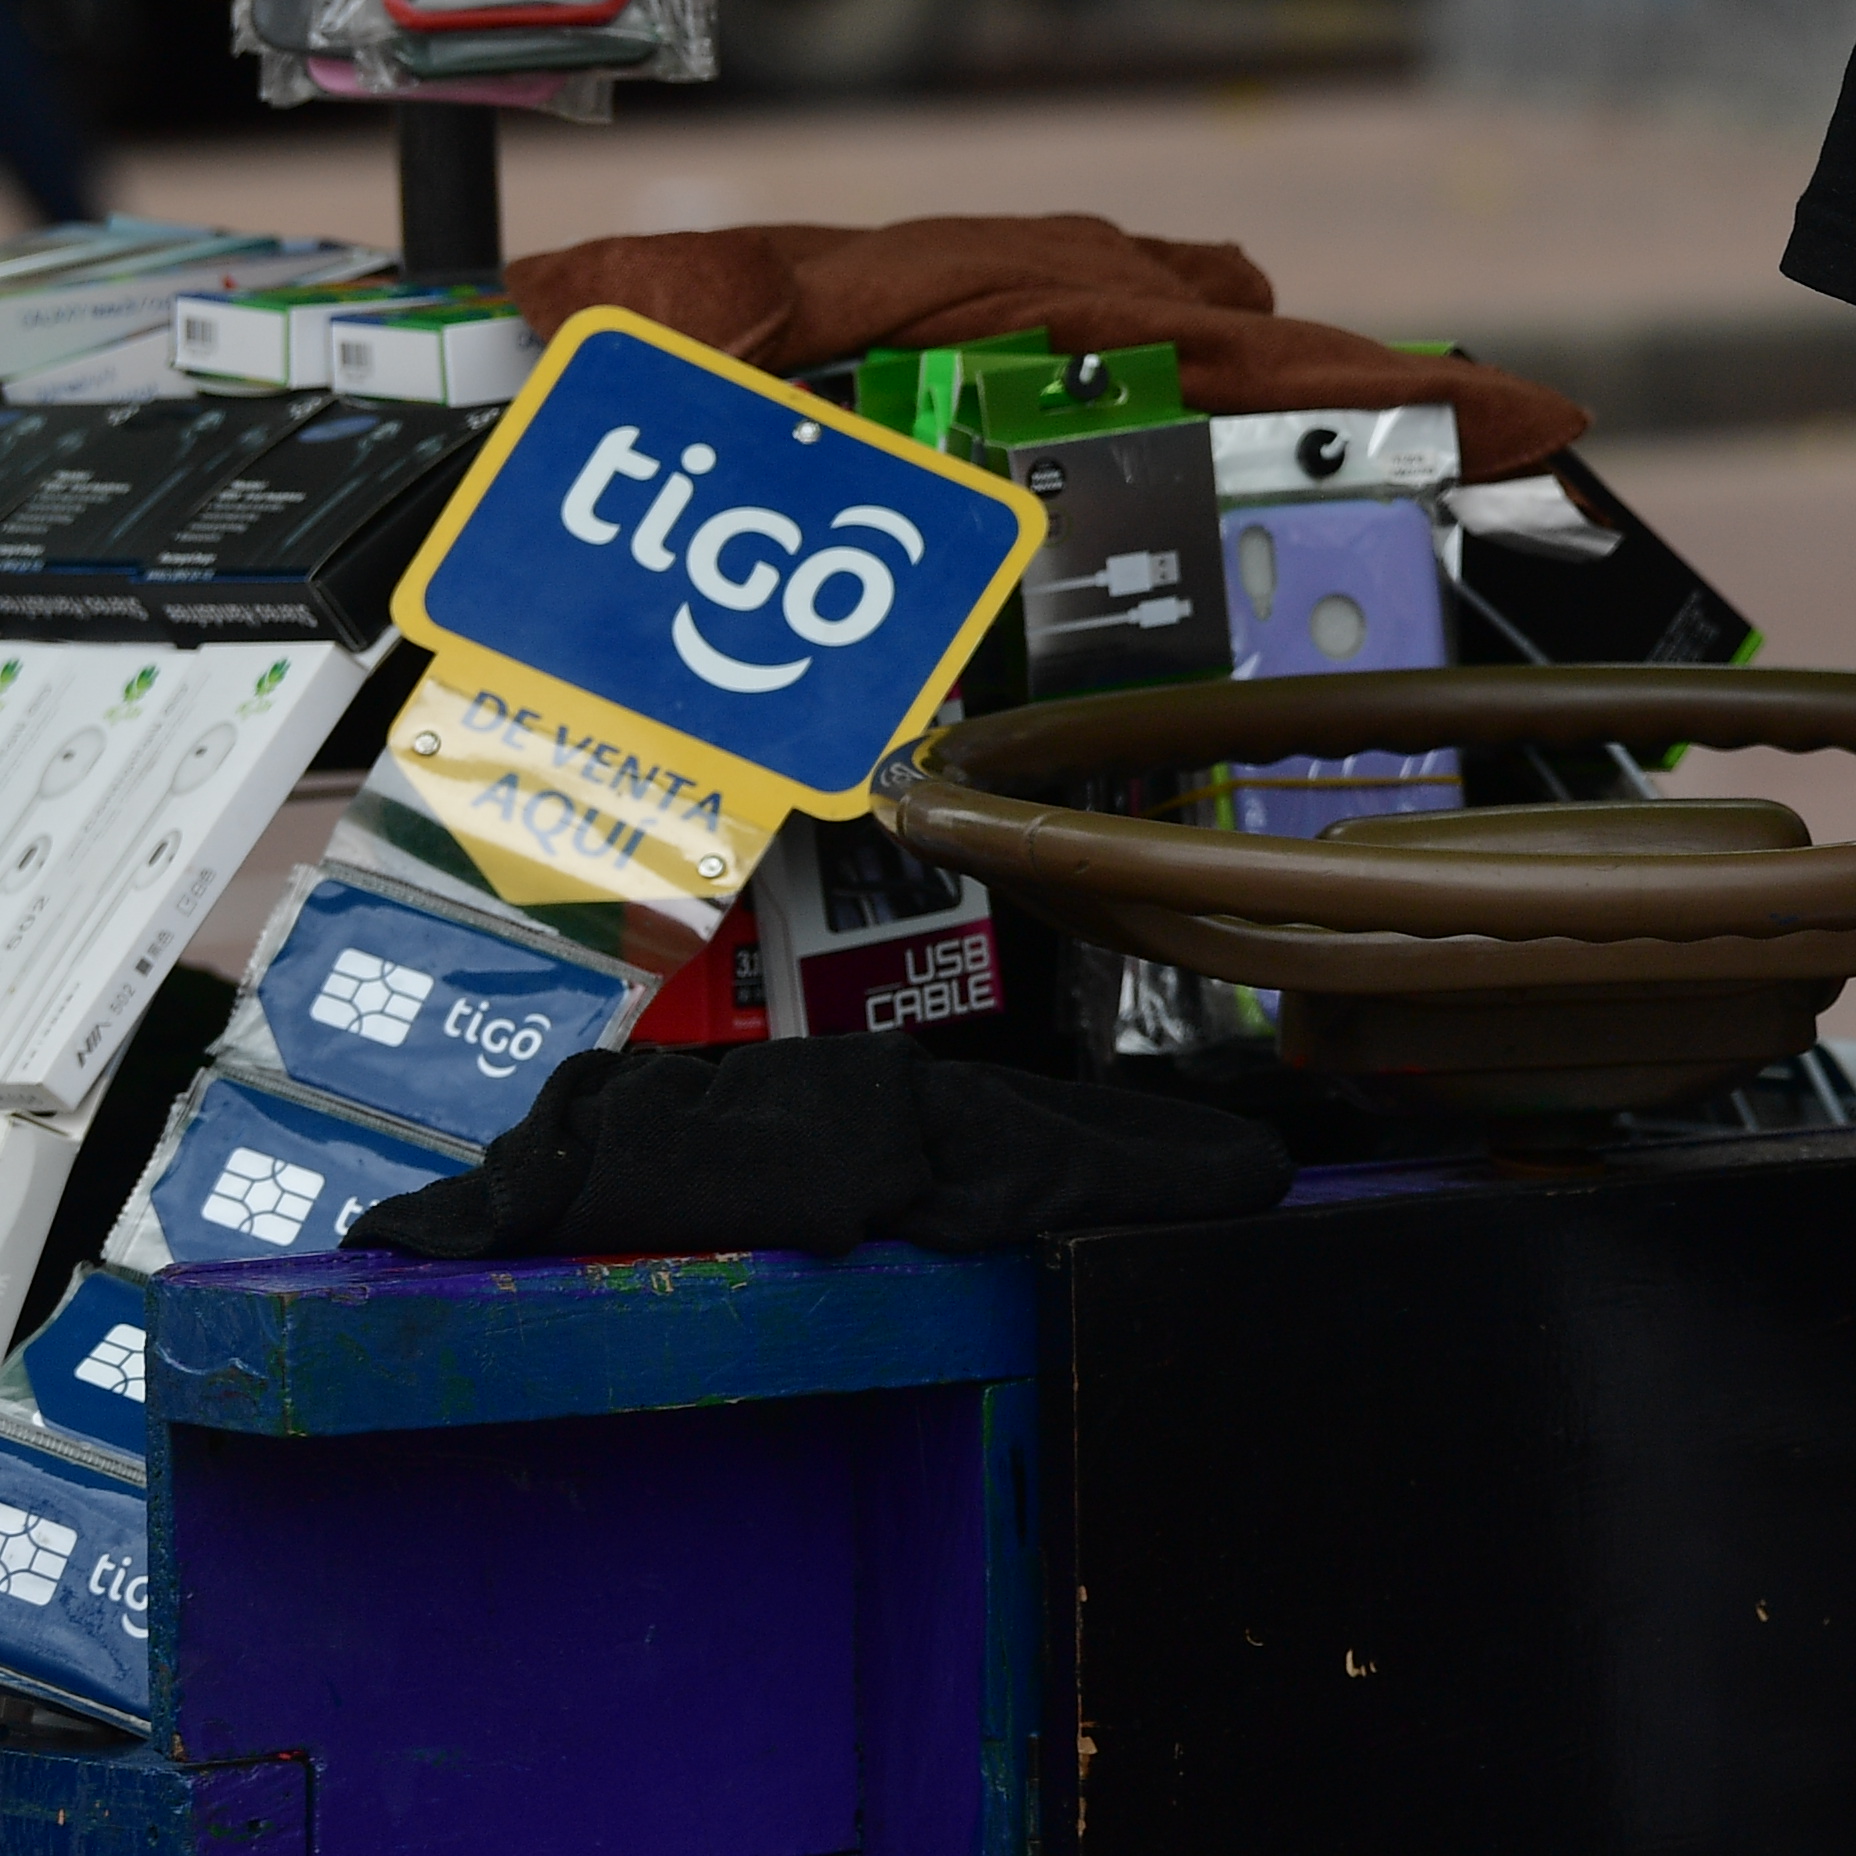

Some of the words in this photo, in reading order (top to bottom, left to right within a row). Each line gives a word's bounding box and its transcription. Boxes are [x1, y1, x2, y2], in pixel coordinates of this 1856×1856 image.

[561, 425, 895, 647] tigo
[460, 690, 542, 751] DE
[552, 725, 723, 833] VENTA
[470, 772, 659, 870] AQUÍ
[904, 934, 990, 985] USB
[443, 997, 544, 1061] tigo
[865, 971, 996, 1033] CABLE
[88, 1553, 149, 1612] tig
